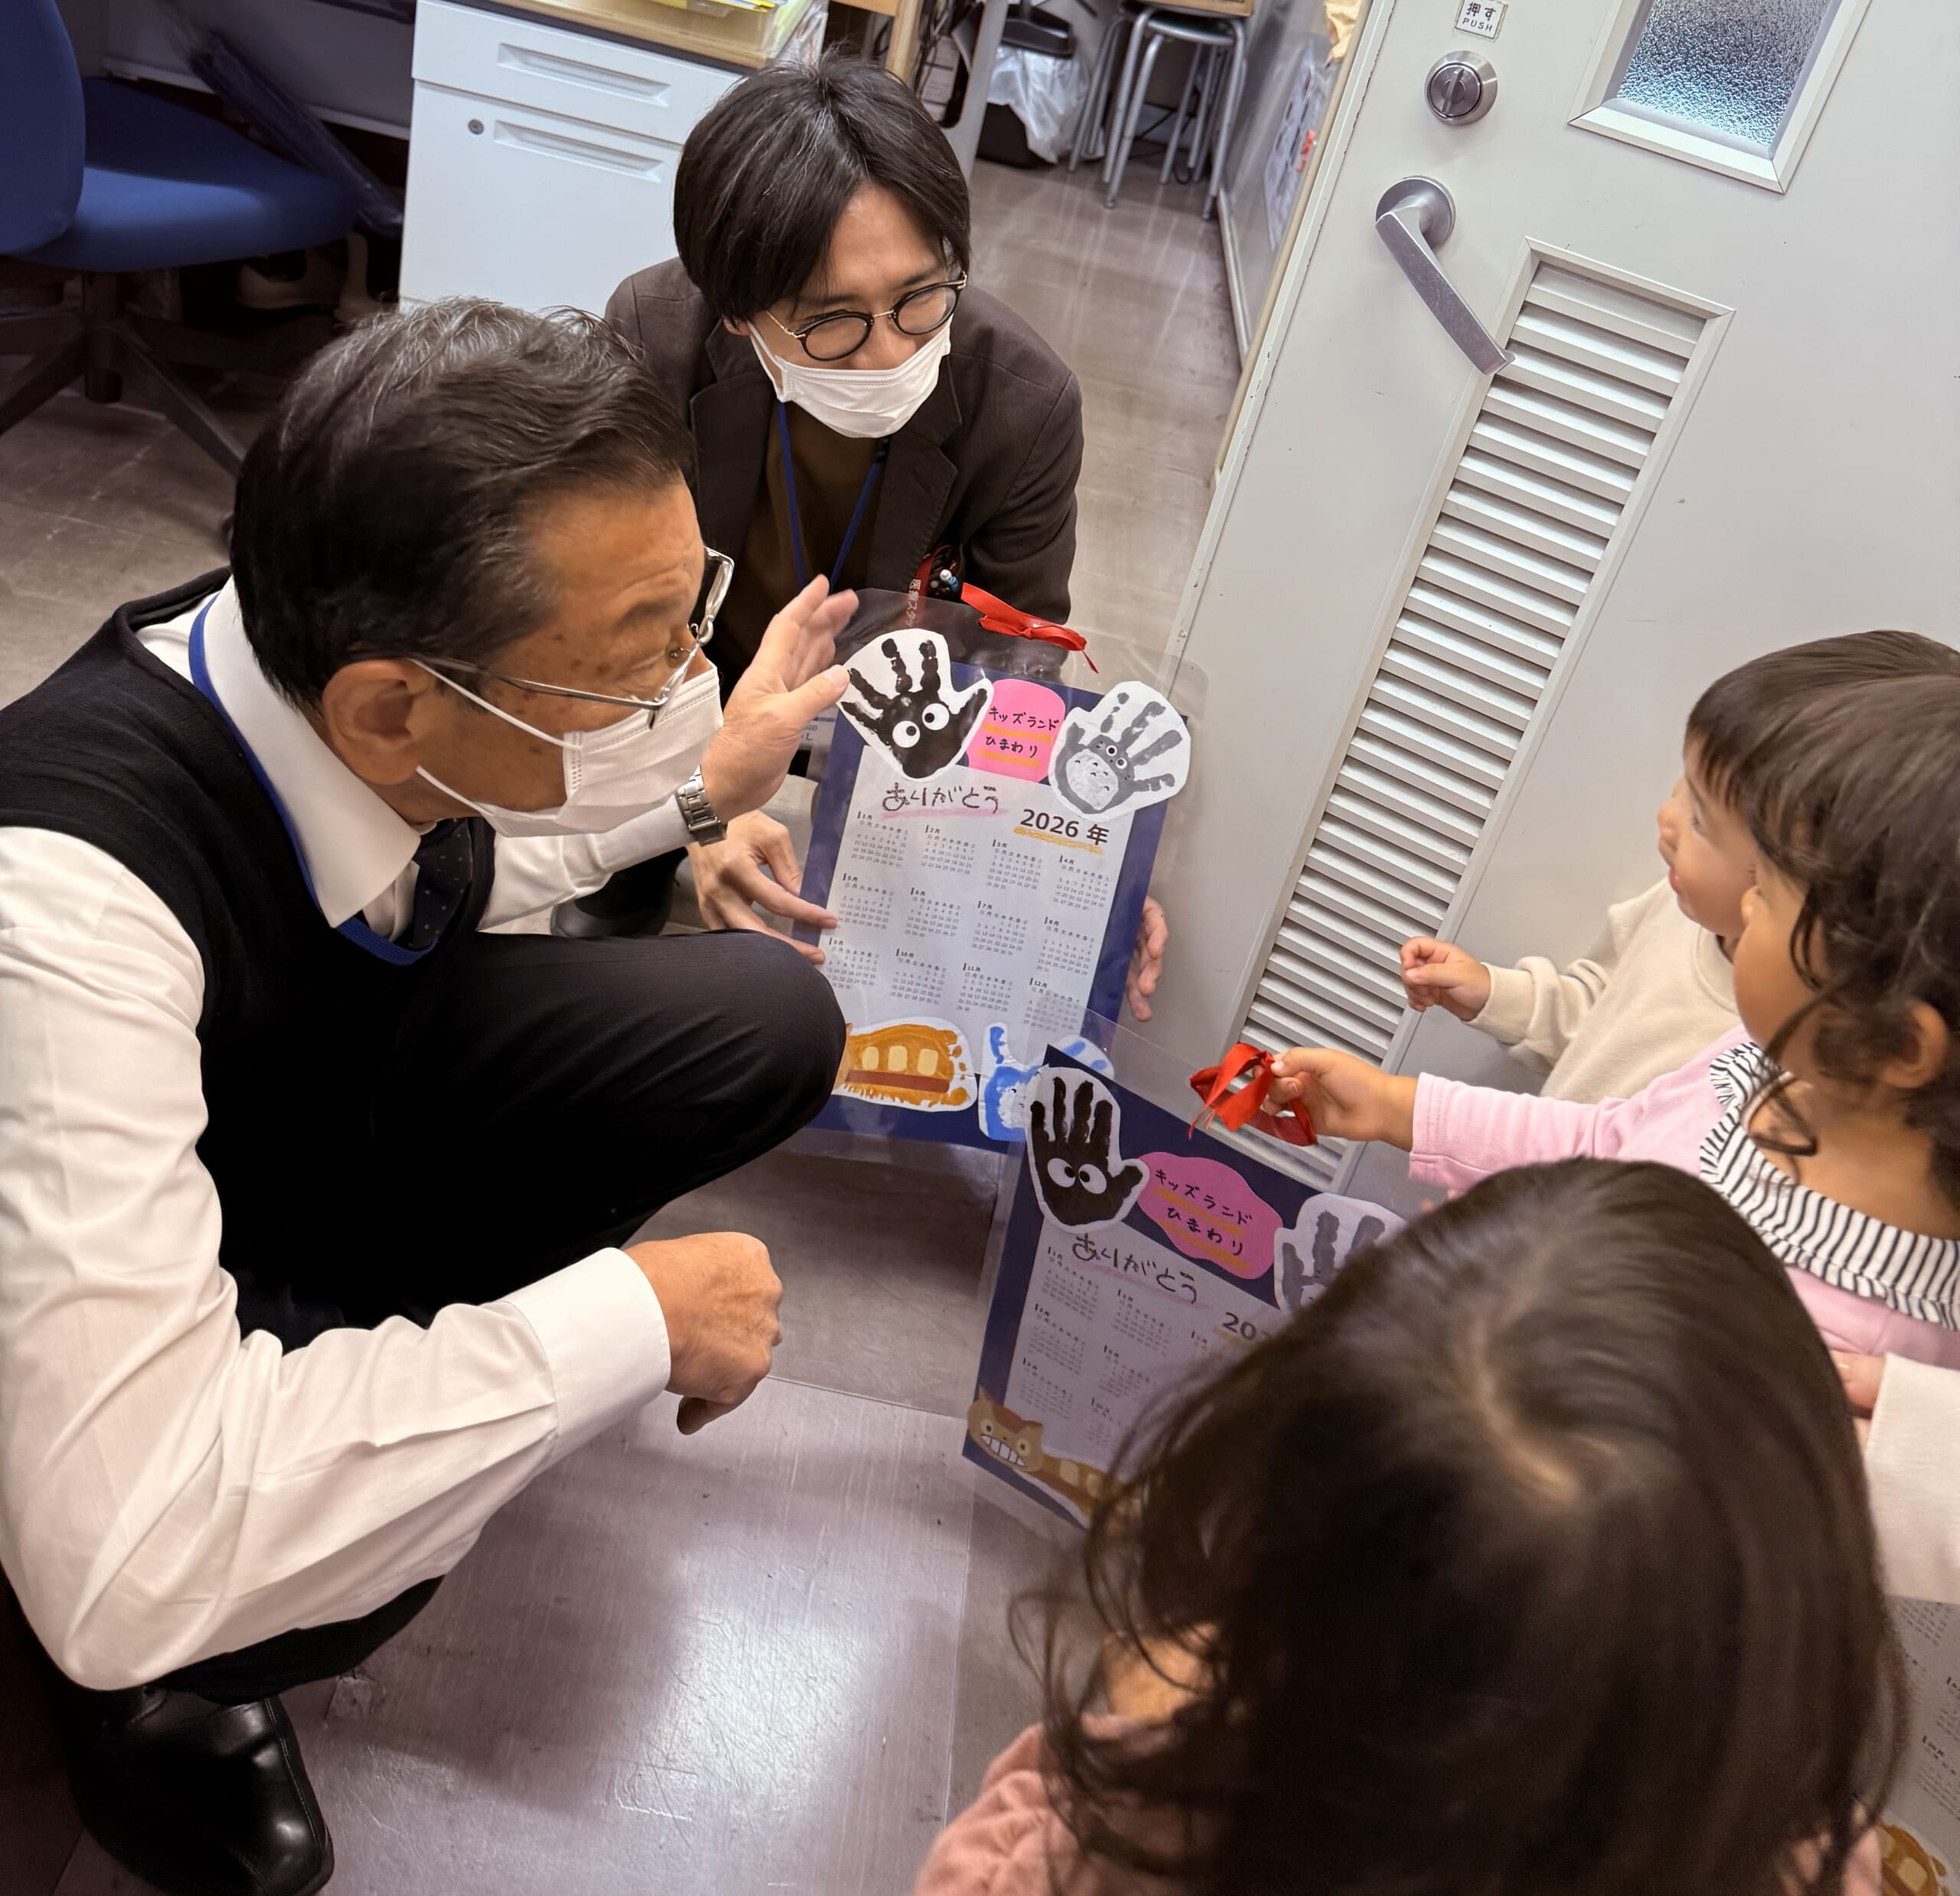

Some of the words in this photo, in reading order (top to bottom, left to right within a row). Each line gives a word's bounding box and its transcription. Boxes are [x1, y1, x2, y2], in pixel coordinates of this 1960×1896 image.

[1462, 18, 1493, 31] PUSH
[1466, 2, 1497, 21] 押す
[989, 706, 1059, 731] キッズランド
[985, 736, 1037, 758] ひまわり
[882, 782, 998, 814] ありがとう
[1020, 809, 1080, 837] 2026
[1086, 823, 1110, 845] 年
[1155, 1169, 1253, 1225] キッズランド
[1167, 1207, 1243, 1256] ひまわり
[1073, 1232, 1197, 1304] ありがとう
[1223, 1312, 1272, 1341] 20
